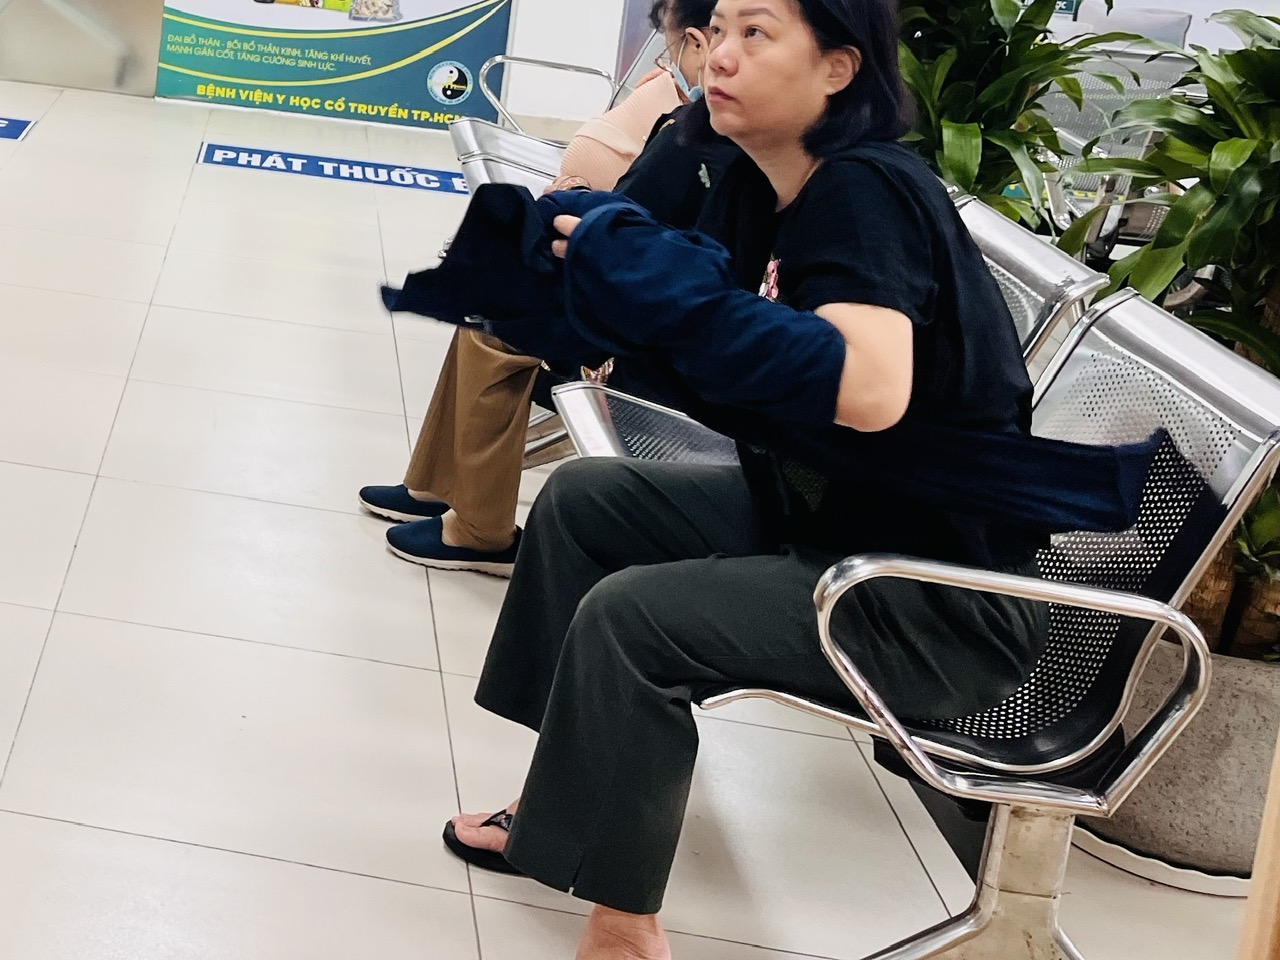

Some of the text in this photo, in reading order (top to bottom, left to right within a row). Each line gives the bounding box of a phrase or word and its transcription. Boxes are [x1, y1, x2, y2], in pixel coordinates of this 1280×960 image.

[298, 59, 317, 69] SINH
[304, 48, 328, 60] TĂNG
[330, 51, 345, 62] KHÍ
[197, 84, 408, 120] BỆNH VIỆN Y HỌC CỔ TRUYỀN
[212, 149, 308, 172] PHÁT
[318, 161, 441, 188] THUỐC
